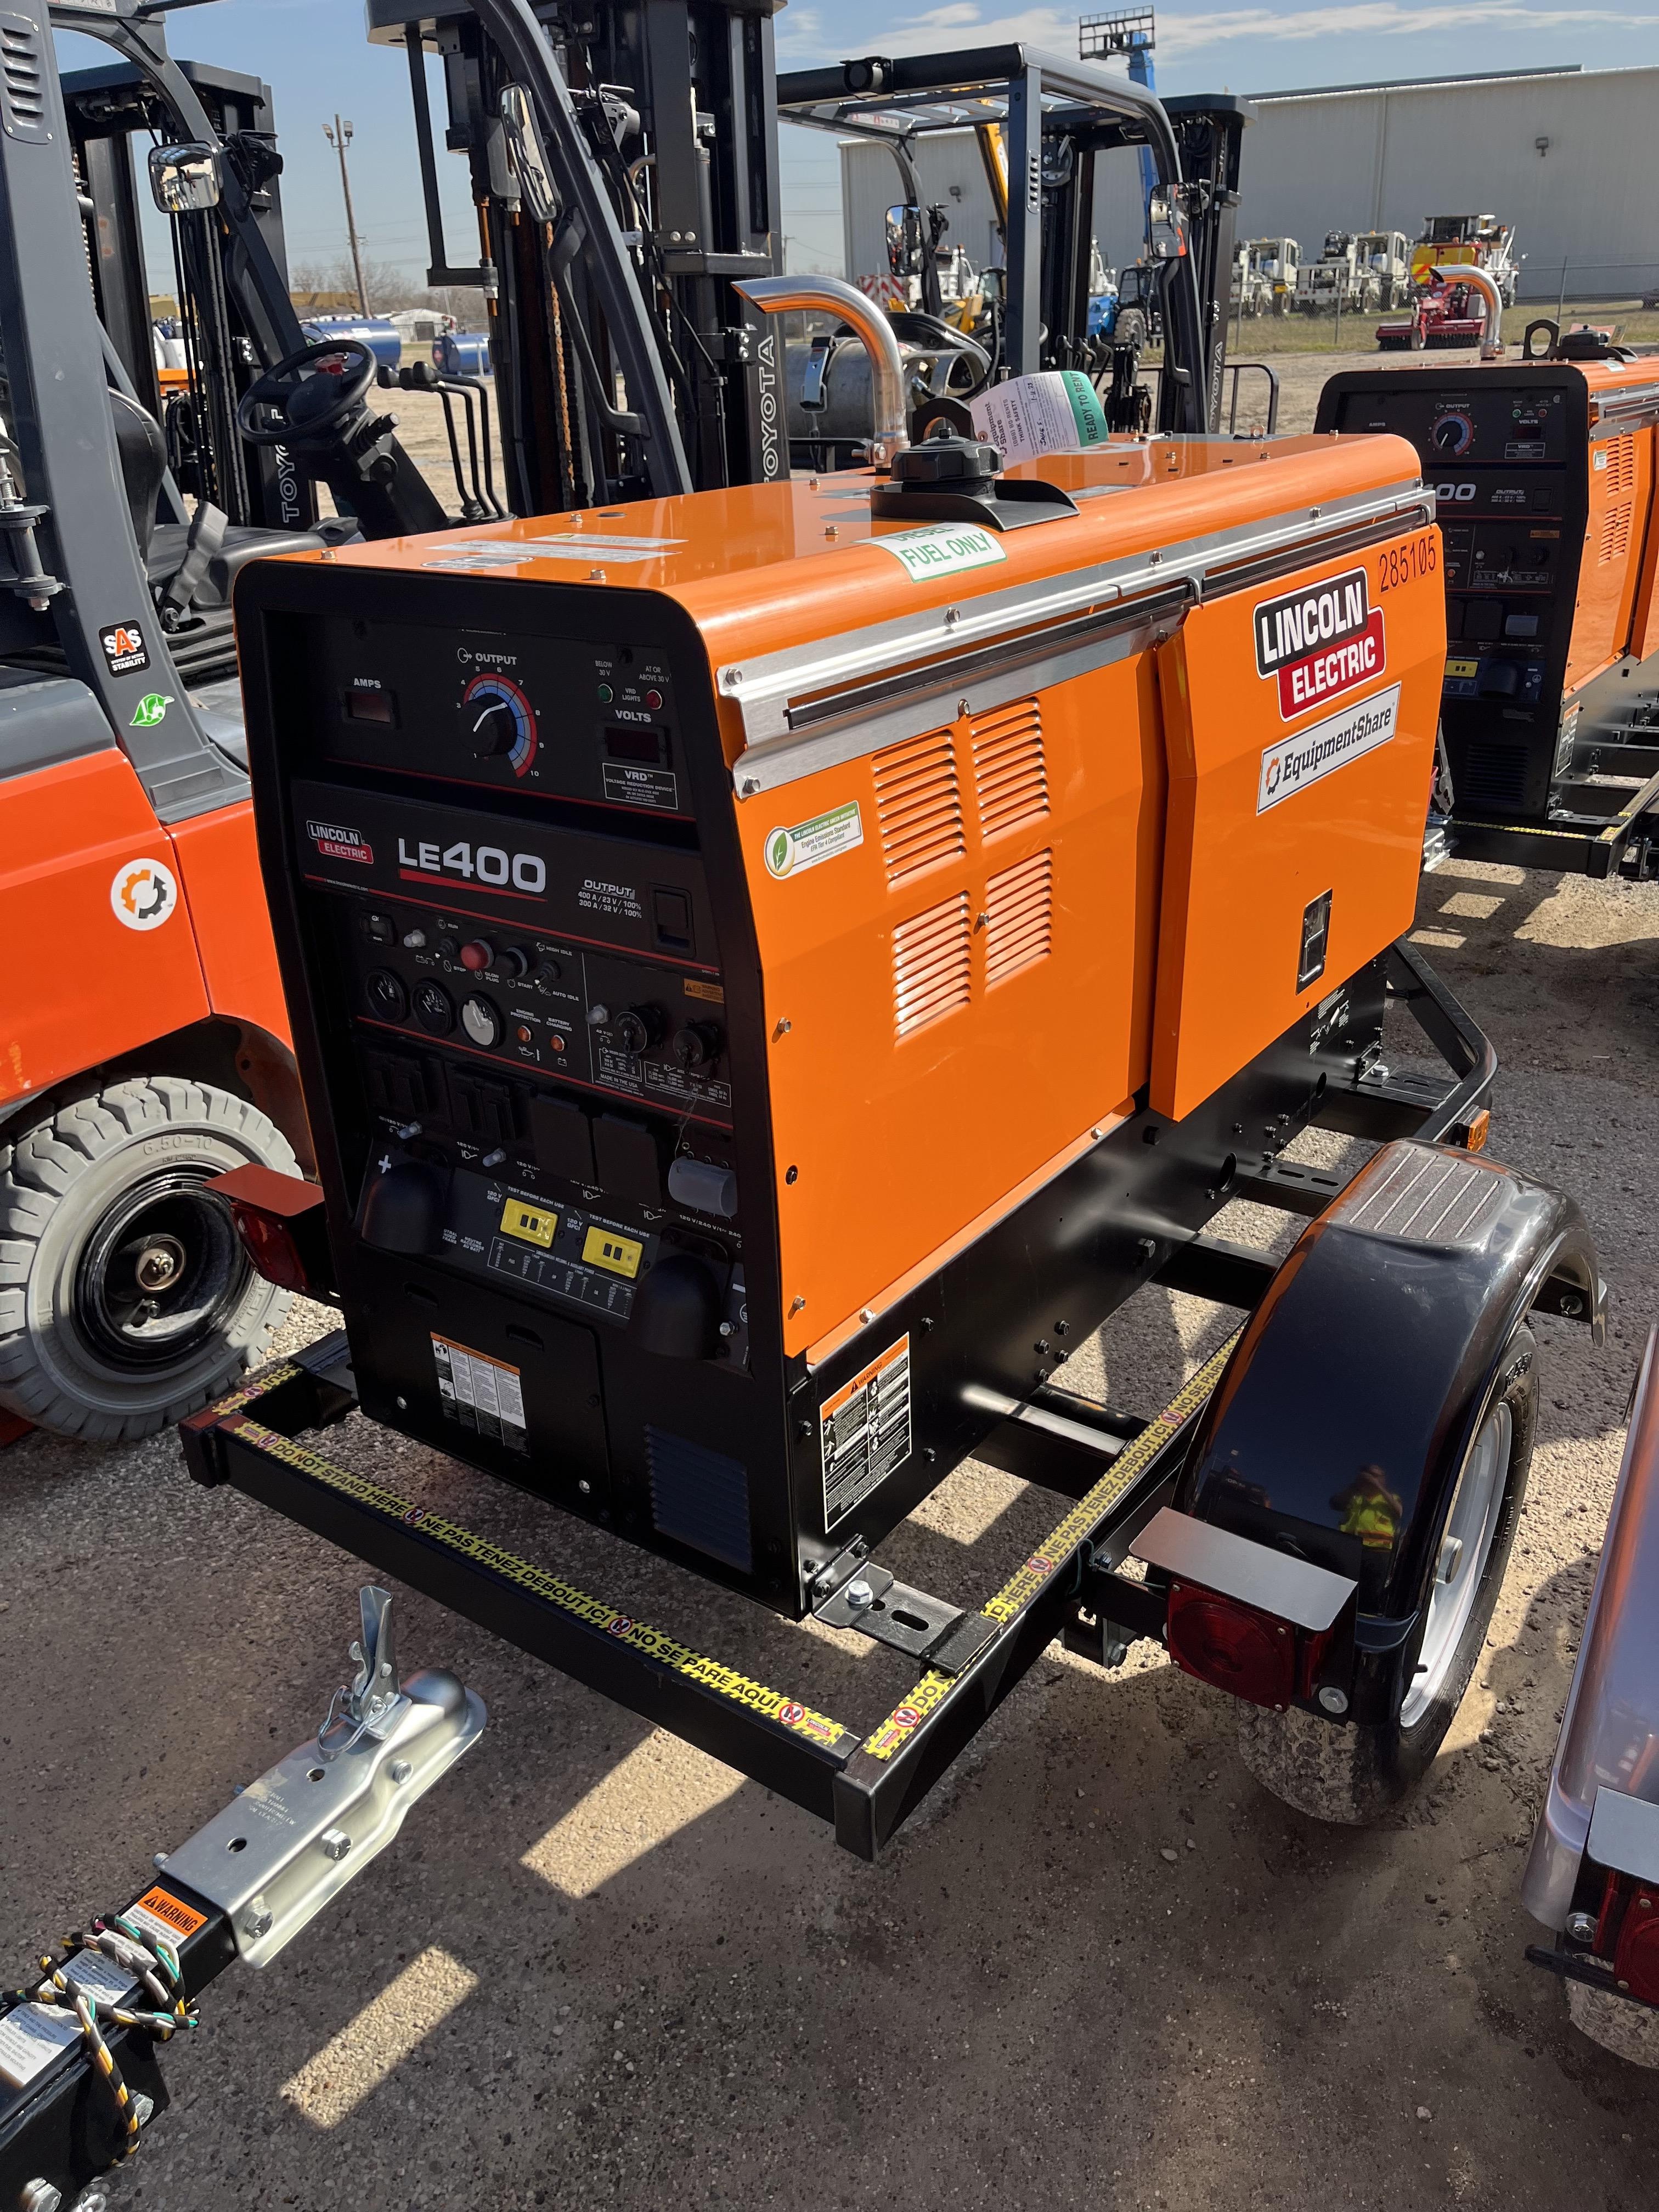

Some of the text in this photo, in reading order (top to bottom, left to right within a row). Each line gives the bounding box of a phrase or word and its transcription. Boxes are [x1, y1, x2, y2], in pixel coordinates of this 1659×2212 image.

[758, 335, 779, 483] OYOTA
[1069, 372, 1098, 441] READY TO RENT
[1011, 399, 1025, 442] THINK SAFETY
[997, 419, 1007, 445] Share
[887, 527, 955, 541] DIESEL
[899, 533, 992, 567] FUEL ONLY
[1379, 534, 1435, 593] 285105
[1262, 581, 1363, 664] LINCOLN
[104, 628, 142, 657] SAS
[112, 657, 146, 671] STABILITY
[475, 652, 517, 666] OUTPUT
[595, 660, 612, 668] BELOW
[639, 673, 657, 682] ABOVE
[1292, 636, 1376, 704] ELECTRIC
[353, 678, 381, 690] AMPS
[622, 694, 641, 703] LIGHTS
[614, 709, 652, 724] VOLTS
[311, 824, 359, 845] LINCOLN
[801, 821, 850, 849] Engine Emissions Standard
[828, 832, 845, 846] Compliant
[324, 842, 367, 860] ELECTRIC
[398, 837, 546, 893] LE400
[584, 879, 632, 896] OUTPUT
[578, 891, 591, 899] 400
[623, 900, 641, 910] 100%
[579, 899, 592, 907] 300
[624, 909, 642, 918] 100%
[510, 1011, 541, 1023] PROTECTION
[516, 1008, 534, 1017] ENGINE
[548, 1017, 570, 1026] BATTERY
[546, 1021, 573, 1032] CHARGING
[600, 1073, 613, 1081] MADE
[516, 1160, 527, 1169] 120
[487, 1195, 500, 1203] GFCI
[507, 1186, 520, 1194] TEST
[520, 1190, 540, 1201] BEFORE
[539, 1197, 554, 1205] EACH
[567, 1222, 580, 1231] GFCI
[589, 1214, 650, 1238] TEST BEFORE EACH USE
[858, 1362, 883, 1386] WARNING
[1174, 1359, 1224, 1413] NO SE PARE
[273, 1443, 408, 1515] DO NOT STAND HERE
[1043, 1423, 1169, 1560] NE PAS TENEZ DEBOUT ICI
[422, 1517, 610, 1623] NE PAS TENEZ DEBOUT ICI
[1006, 1571, 1038, 1602] HERE
[629, 1627, 730, 1688] NO SE PARE
[912, 1685, 938, 1709] DO
[807, 1717, 830, 1731] LINCOLN
[876, 1729, 894, 1749] LINCOLN
[154, 1898, 198, 1932] WARNING
[25, 2023, 37, 2033] CHAINS
